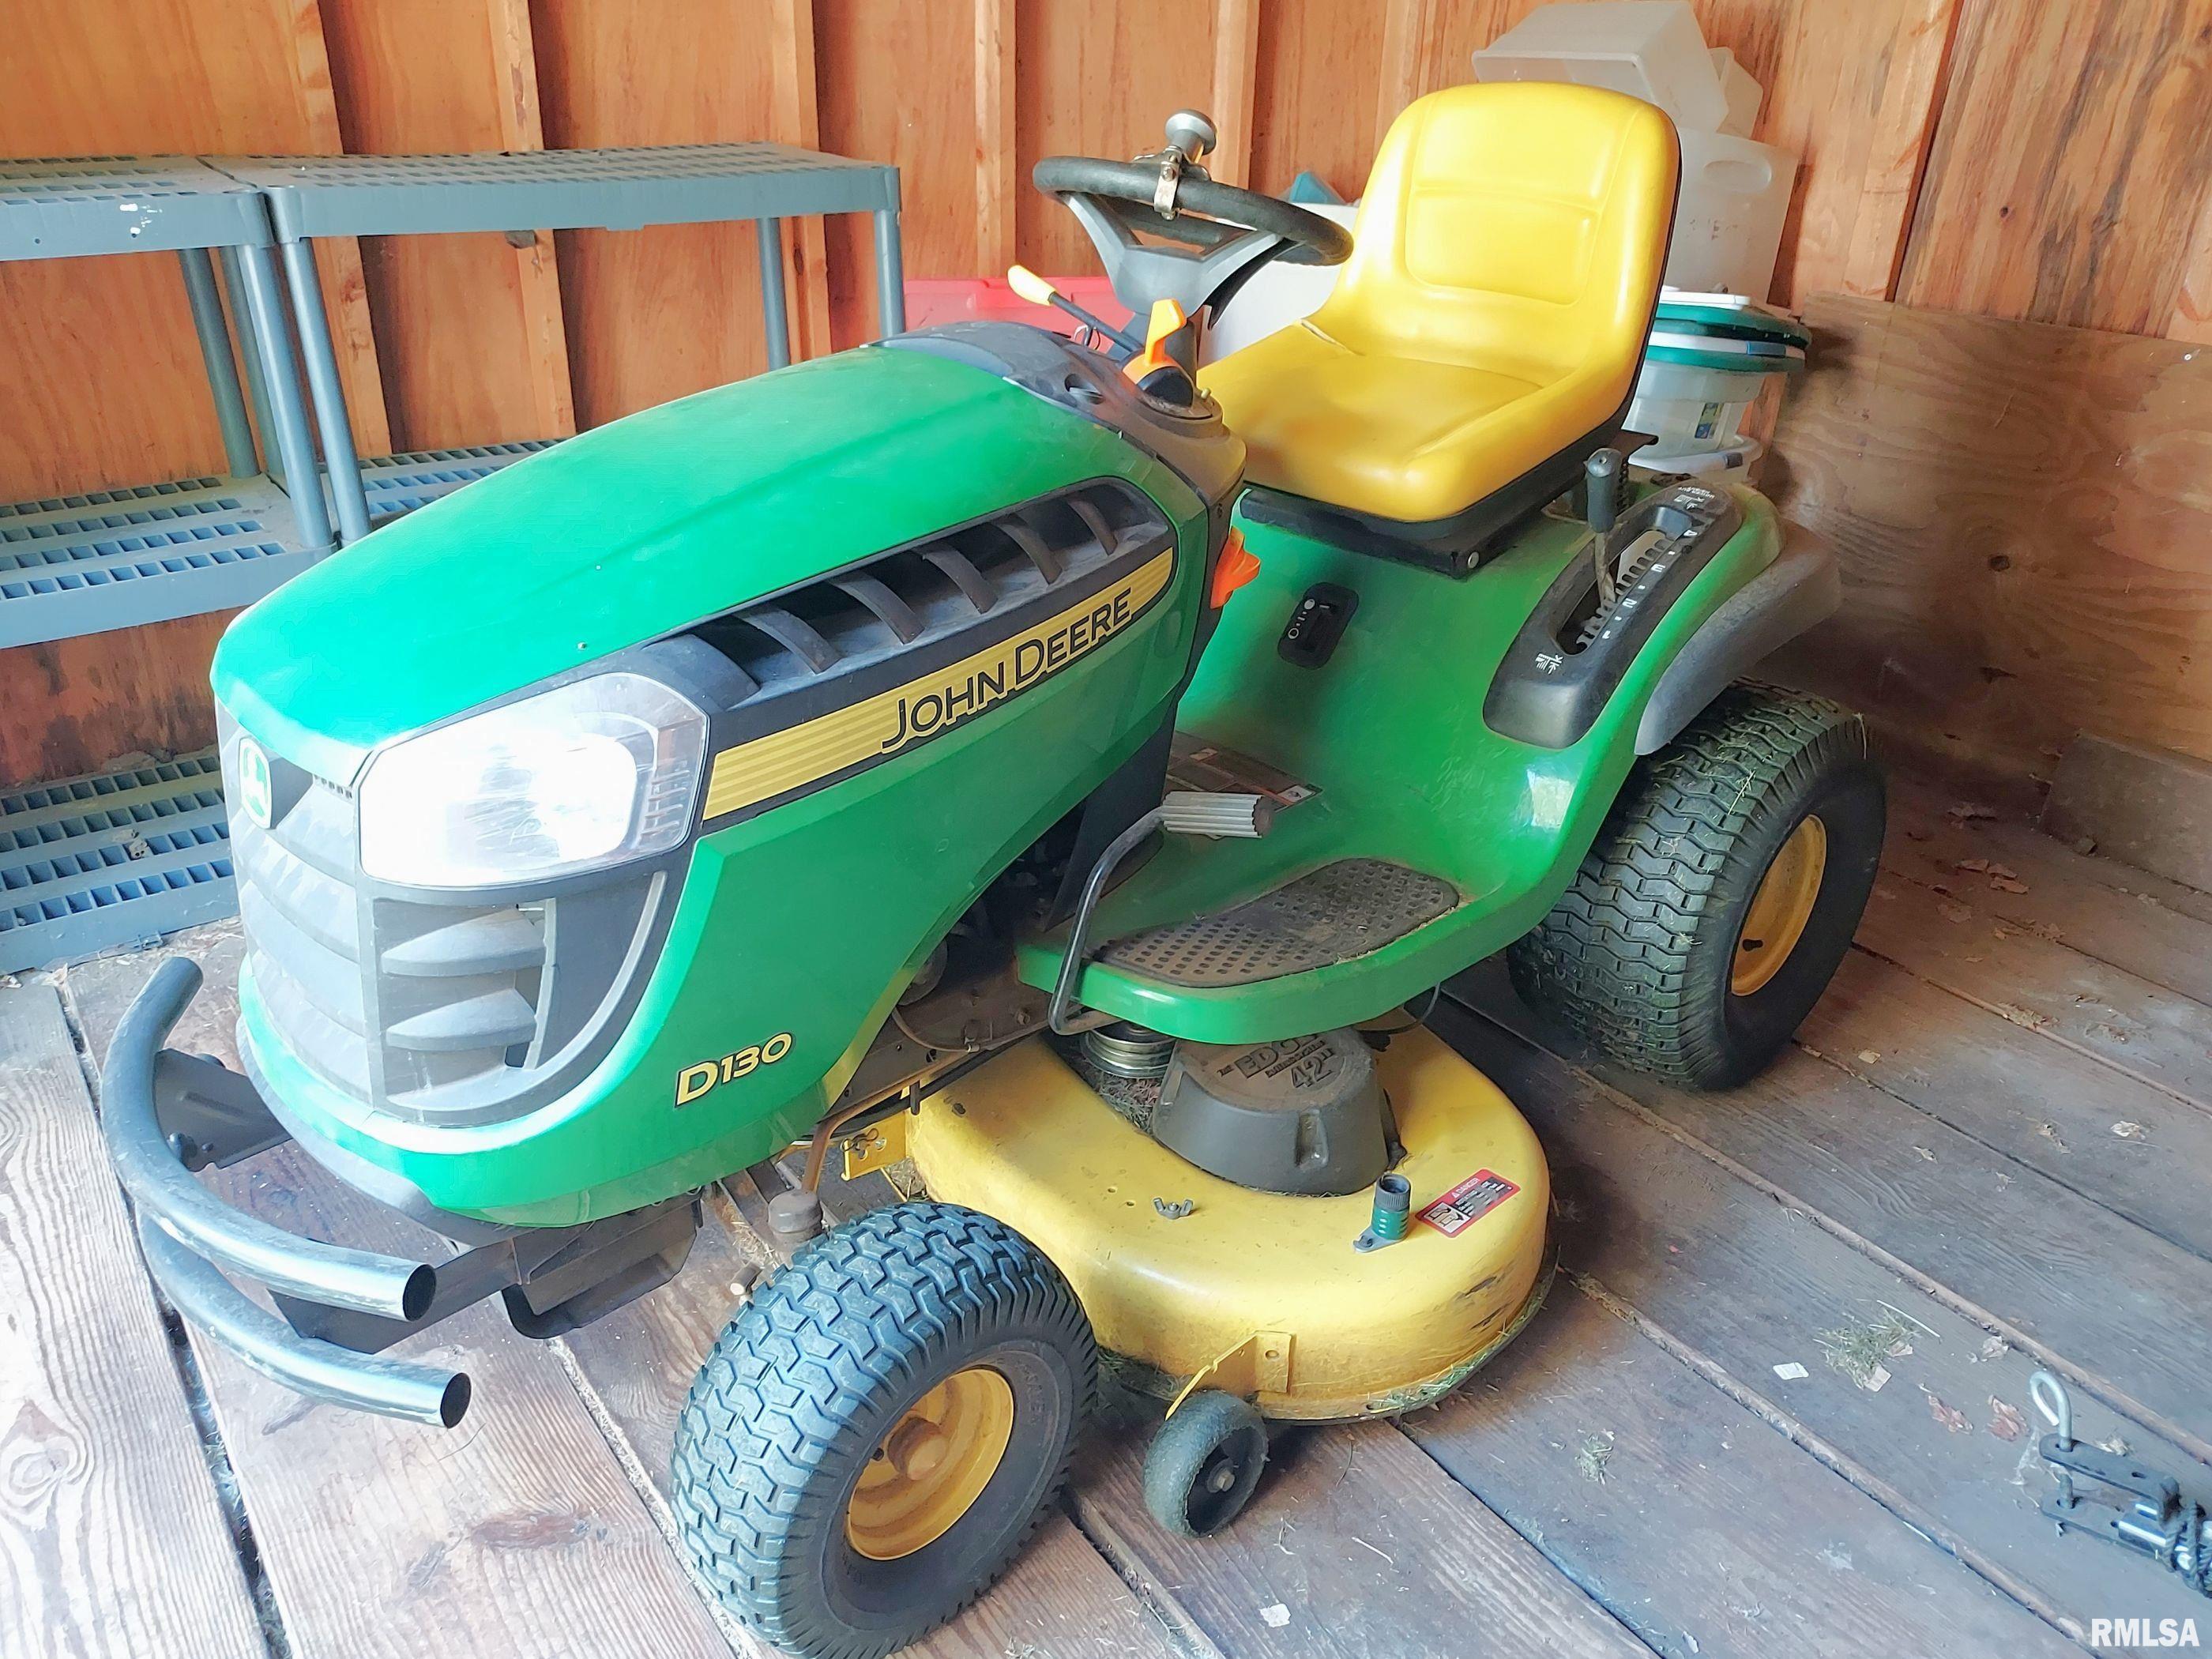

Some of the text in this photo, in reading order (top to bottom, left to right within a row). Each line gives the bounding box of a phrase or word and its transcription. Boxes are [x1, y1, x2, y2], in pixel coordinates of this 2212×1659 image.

[1651, 563, 1666, 573] 3
[1622, 597, 1638, 608] 2
[1601, 630, 1611, 639] 1
[882, 587, 1131, 749] JOHN DEERE
[675, 1032, 794, 1108] D130
[1234, 1034, 1319, 1079] EDG
